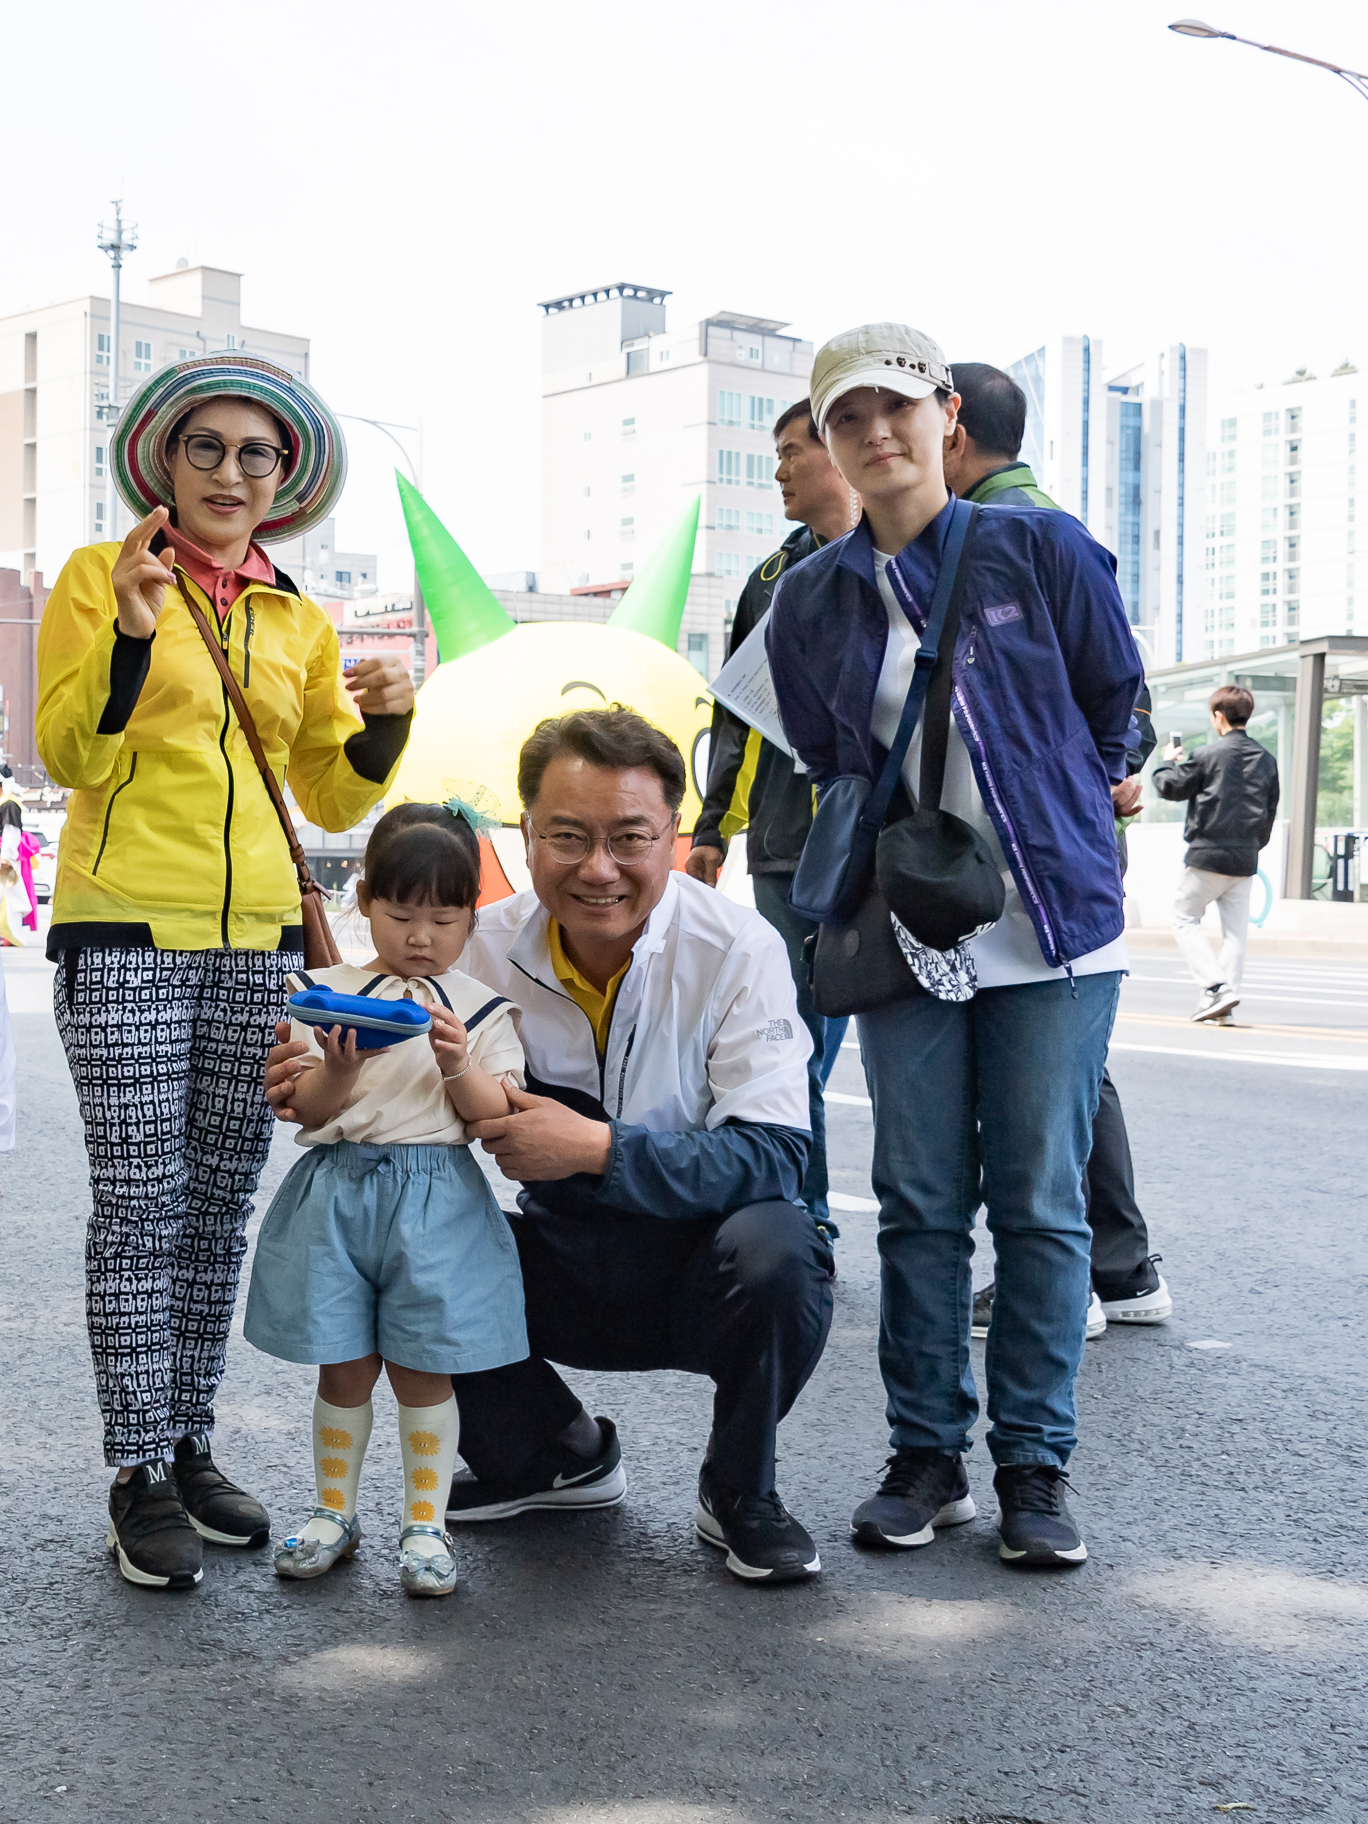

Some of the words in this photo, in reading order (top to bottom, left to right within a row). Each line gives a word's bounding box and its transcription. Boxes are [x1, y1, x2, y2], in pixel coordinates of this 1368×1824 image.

[768, 1019, 782, 1027] THE
[756, 1027, 783, 1037] NORTH
[766, 1034, 784, 1042] FACE
[192, 1434, 209, 1455] M
[146, 1461, 167, 1484] M
